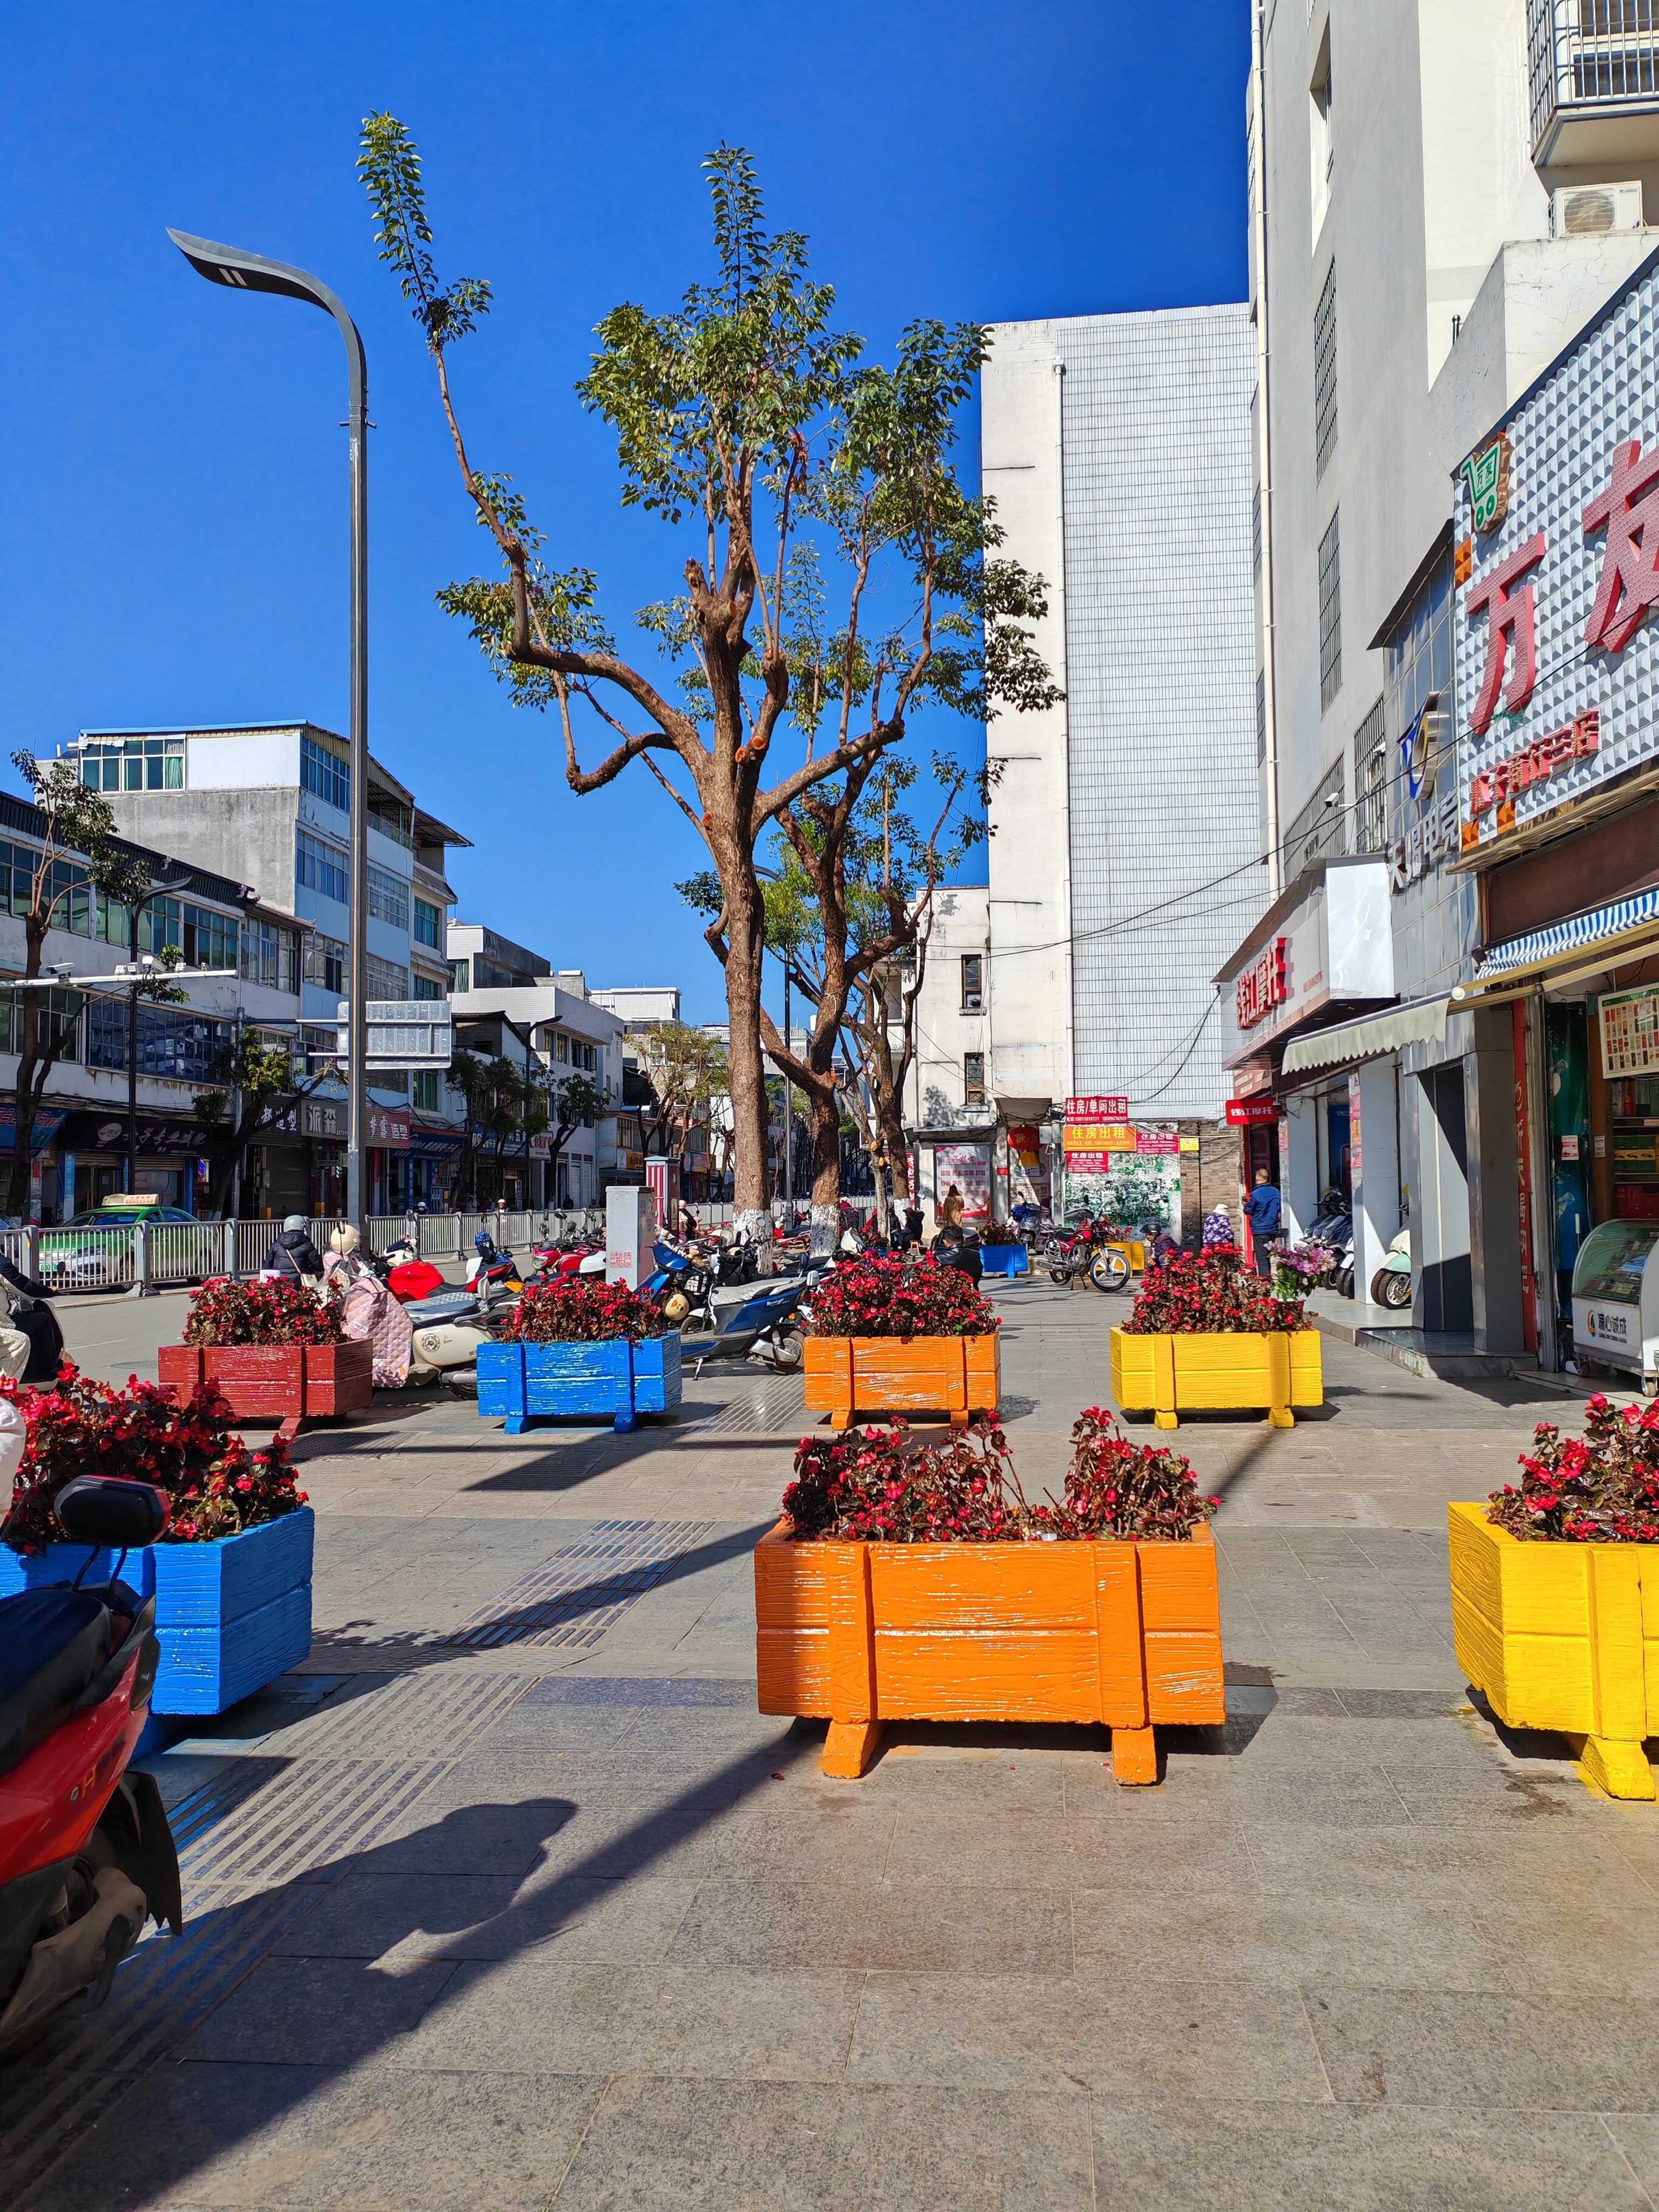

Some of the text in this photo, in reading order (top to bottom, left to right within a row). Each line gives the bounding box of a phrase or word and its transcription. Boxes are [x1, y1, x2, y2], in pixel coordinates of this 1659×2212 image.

[1478, 461, 1493, 488] 万友
[1237, 938, 1287, 1029] 钱江摩托
[1066, 1099, 1127, 1115] 住房/单间出租
[1231, 1107, 1273, 1117] 钱江摩托
[1071, 1127, 1125, 1139] 住房出租
